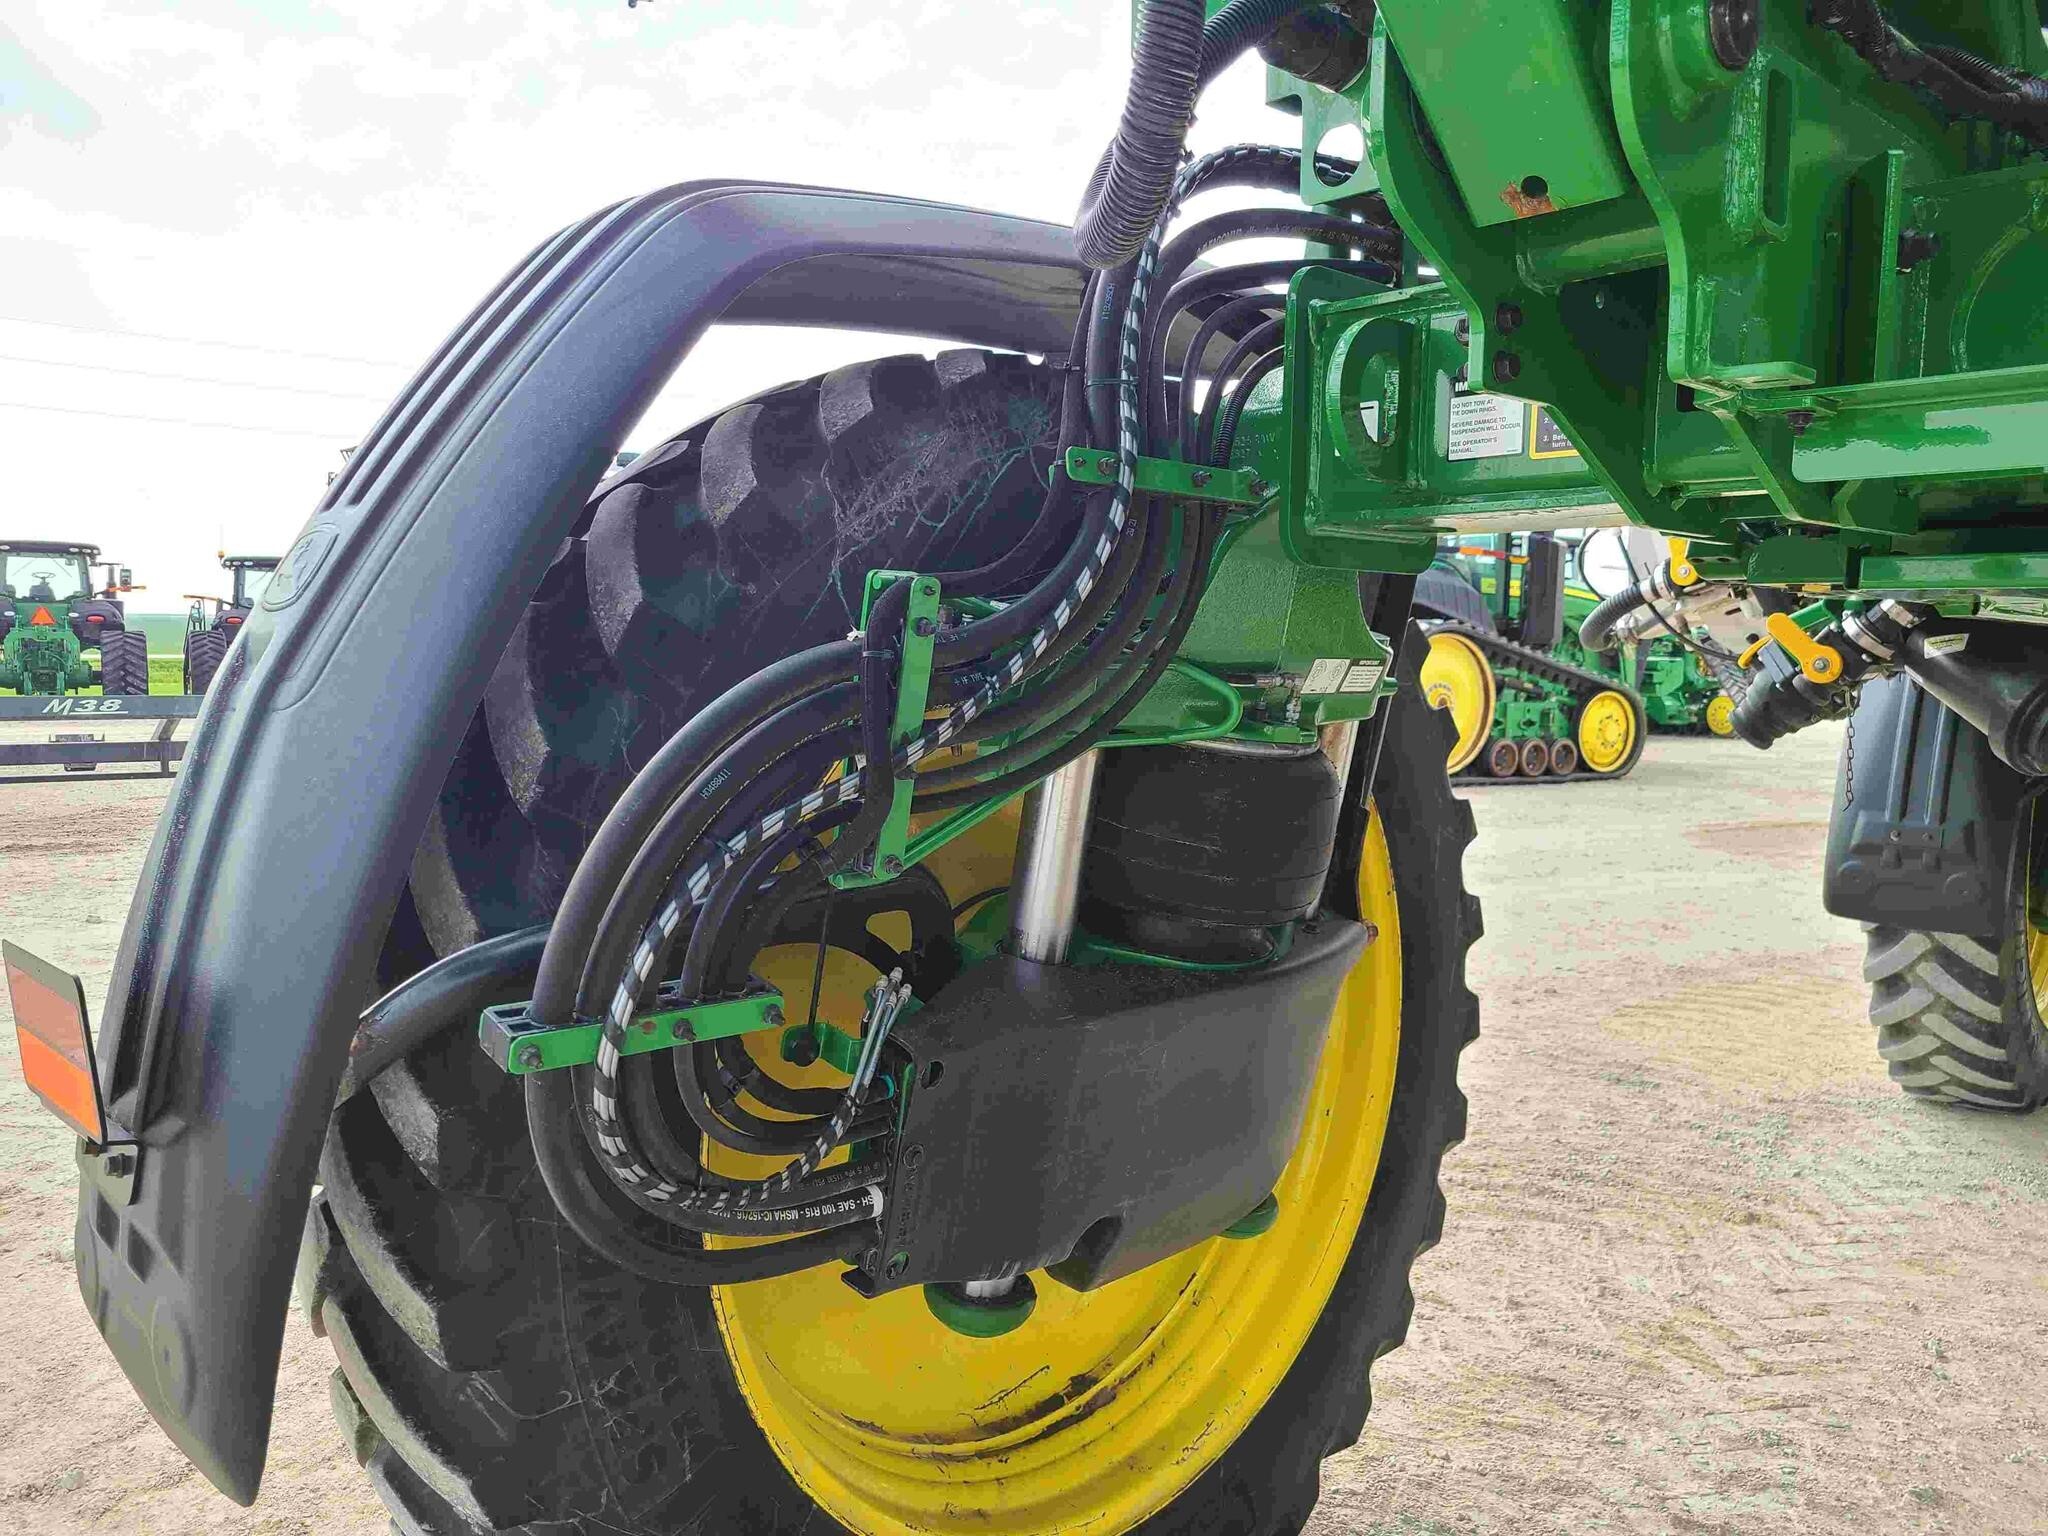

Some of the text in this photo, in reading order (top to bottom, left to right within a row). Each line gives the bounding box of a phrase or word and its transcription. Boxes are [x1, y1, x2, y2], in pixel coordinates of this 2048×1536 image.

[1451, 427, 1485, 435] SUSPENSION
[41, 698, 123, 715] M38
[805, 1204, 820, 1218] R15
[822, 1202, 836, 1216] 100
[838, 1198, 856, 1213] SAE
[773, 1208, 799, 1221] MSHA
